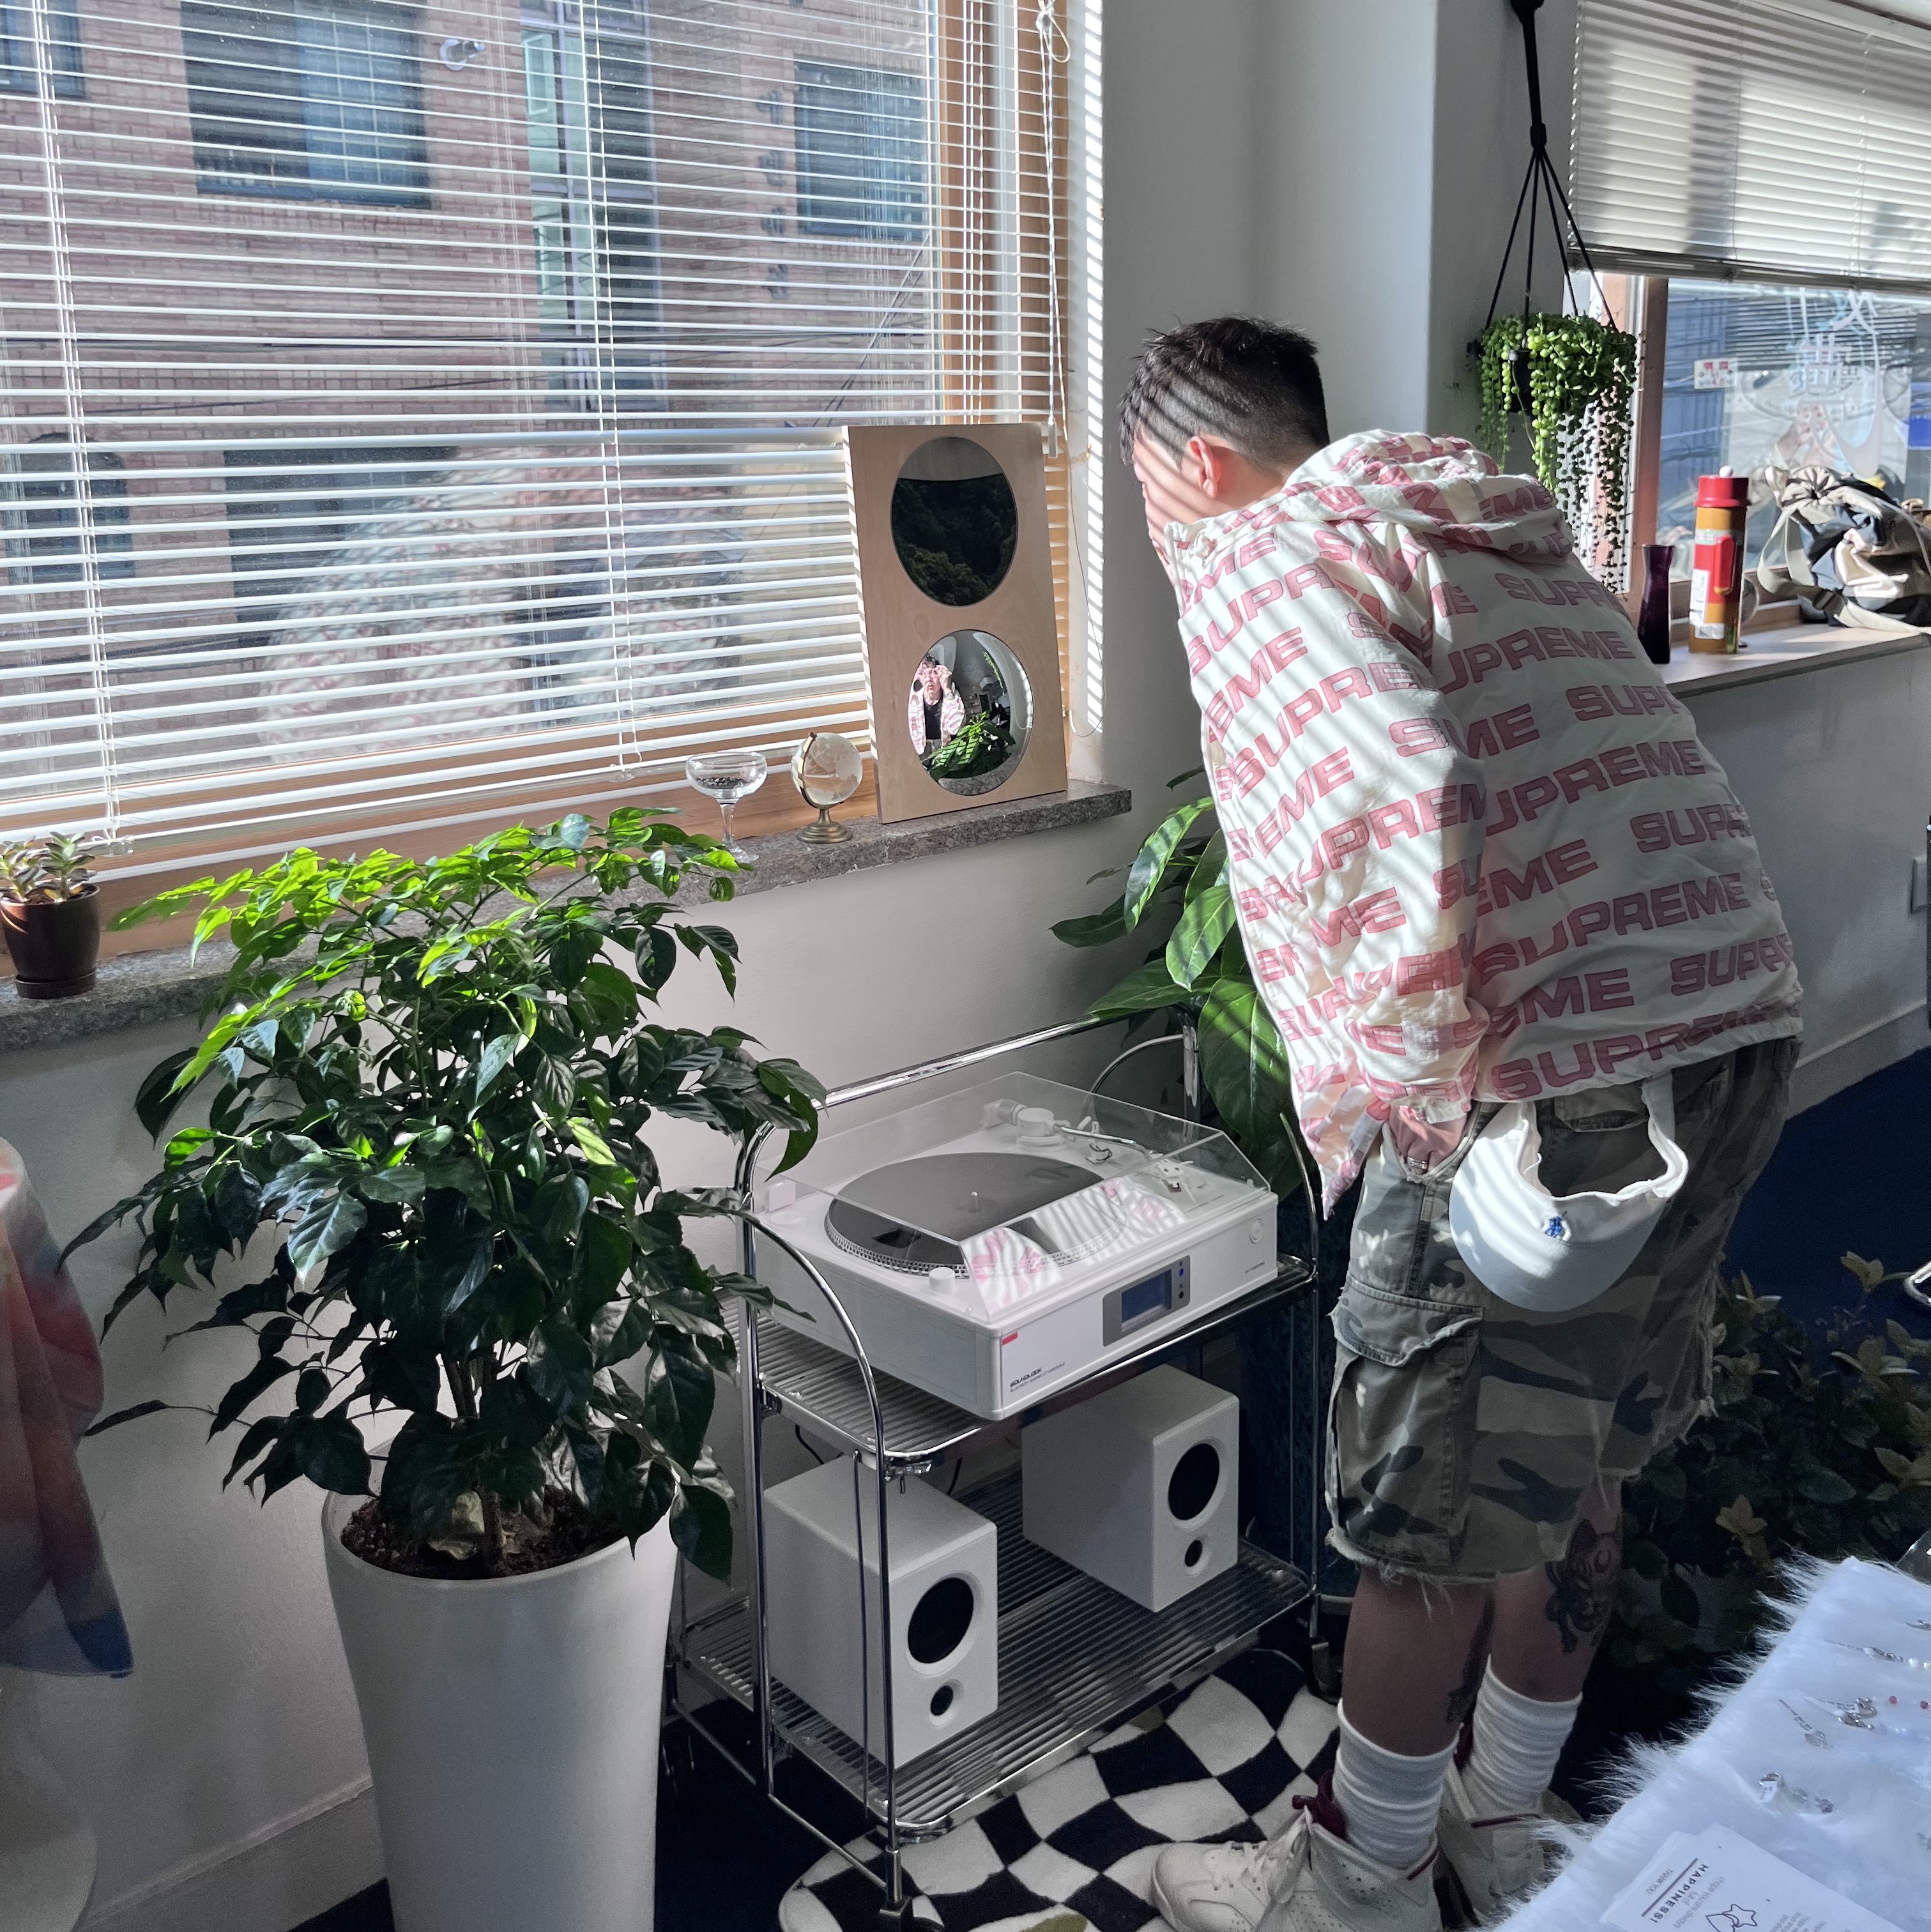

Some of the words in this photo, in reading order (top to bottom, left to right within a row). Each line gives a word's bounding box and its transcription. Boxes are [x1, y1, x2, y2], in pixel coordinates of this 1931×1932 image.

[1439, 627, 1636, 695] UPREME
[1485, 740, 1706, 838] UPREME
[1472, 872, 1751, 985] SUPREME
[1646, 1883, 1659, 1895] YOU
[1658, 1869, 1674, 1885] THANK
